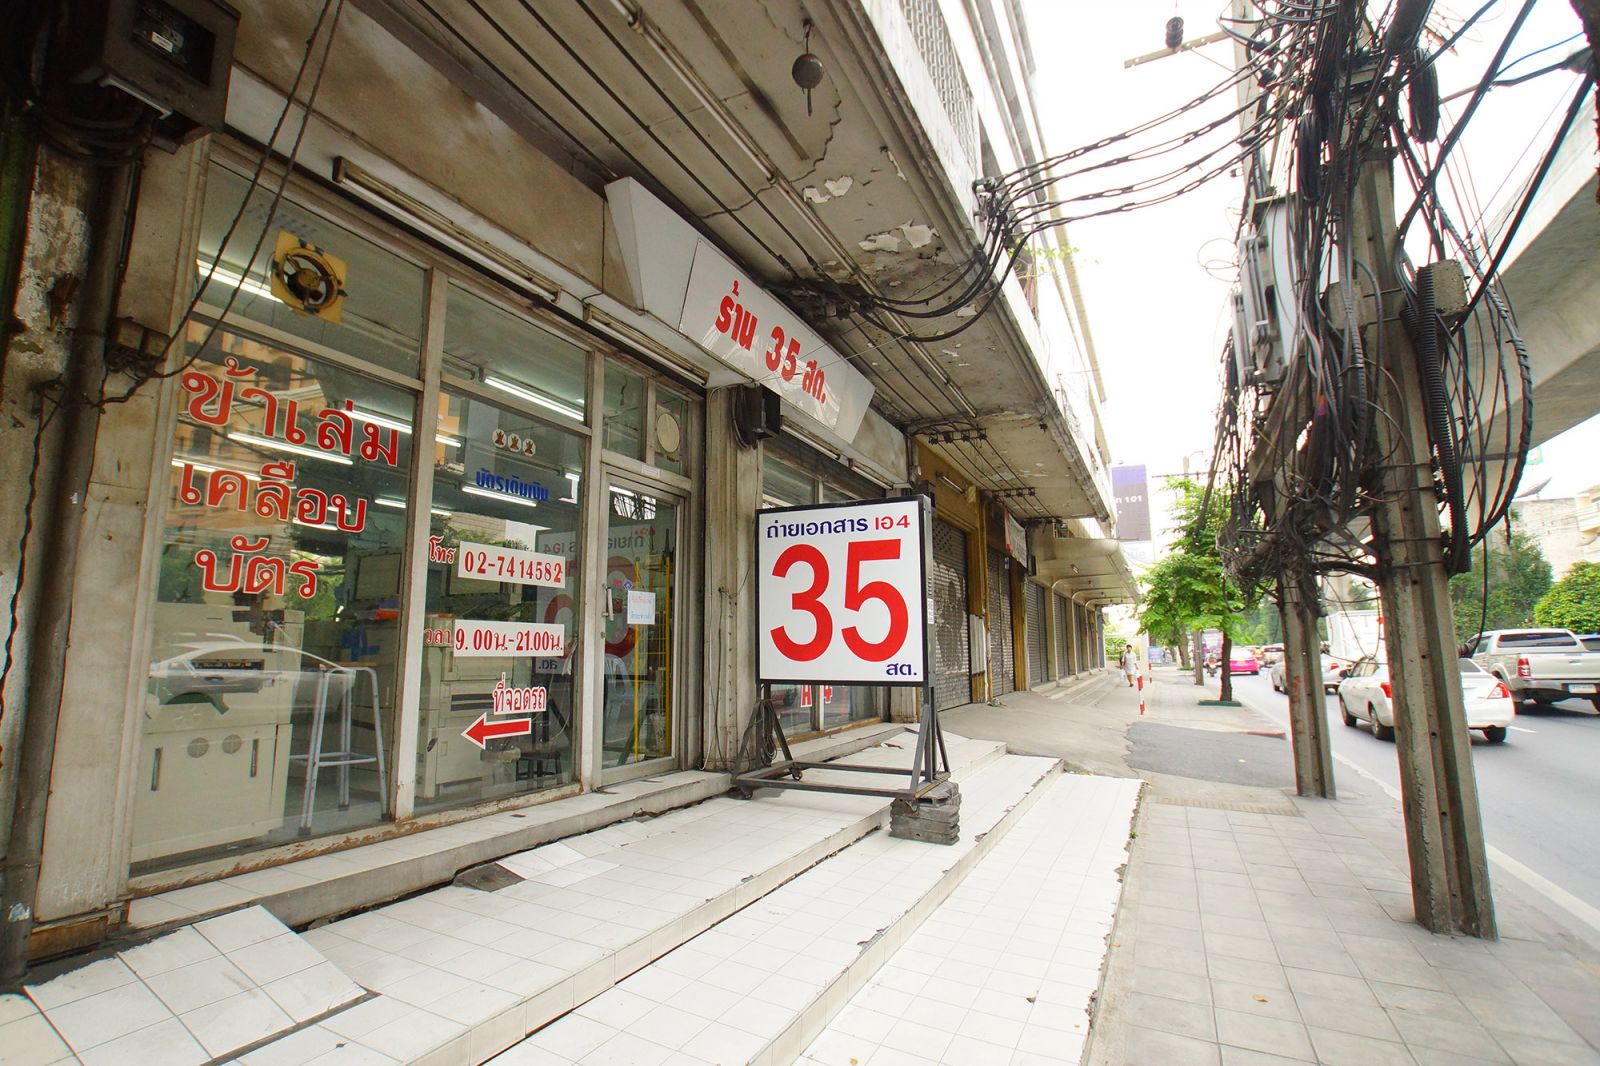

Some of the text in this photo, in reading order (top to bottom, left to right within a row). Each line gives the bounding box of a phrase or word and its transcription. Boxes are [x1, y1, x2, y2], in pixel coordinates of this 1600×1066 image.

[714, 279, 758, 352] ร้าน
[765, 325, 801, 382] 35
[179, 460, 368, 533] เคลือบ
[428, 535, 455, 564] โทร
[766, 514, 911, 539] ถ่ายเอกสาร เอ4
[194, 535, 321, 599] บัตร
[770, 538, 909, 663] 35
[492, 672, 546, 713] ที่จอดรถ
[885, 662, 918, 677] สต.
